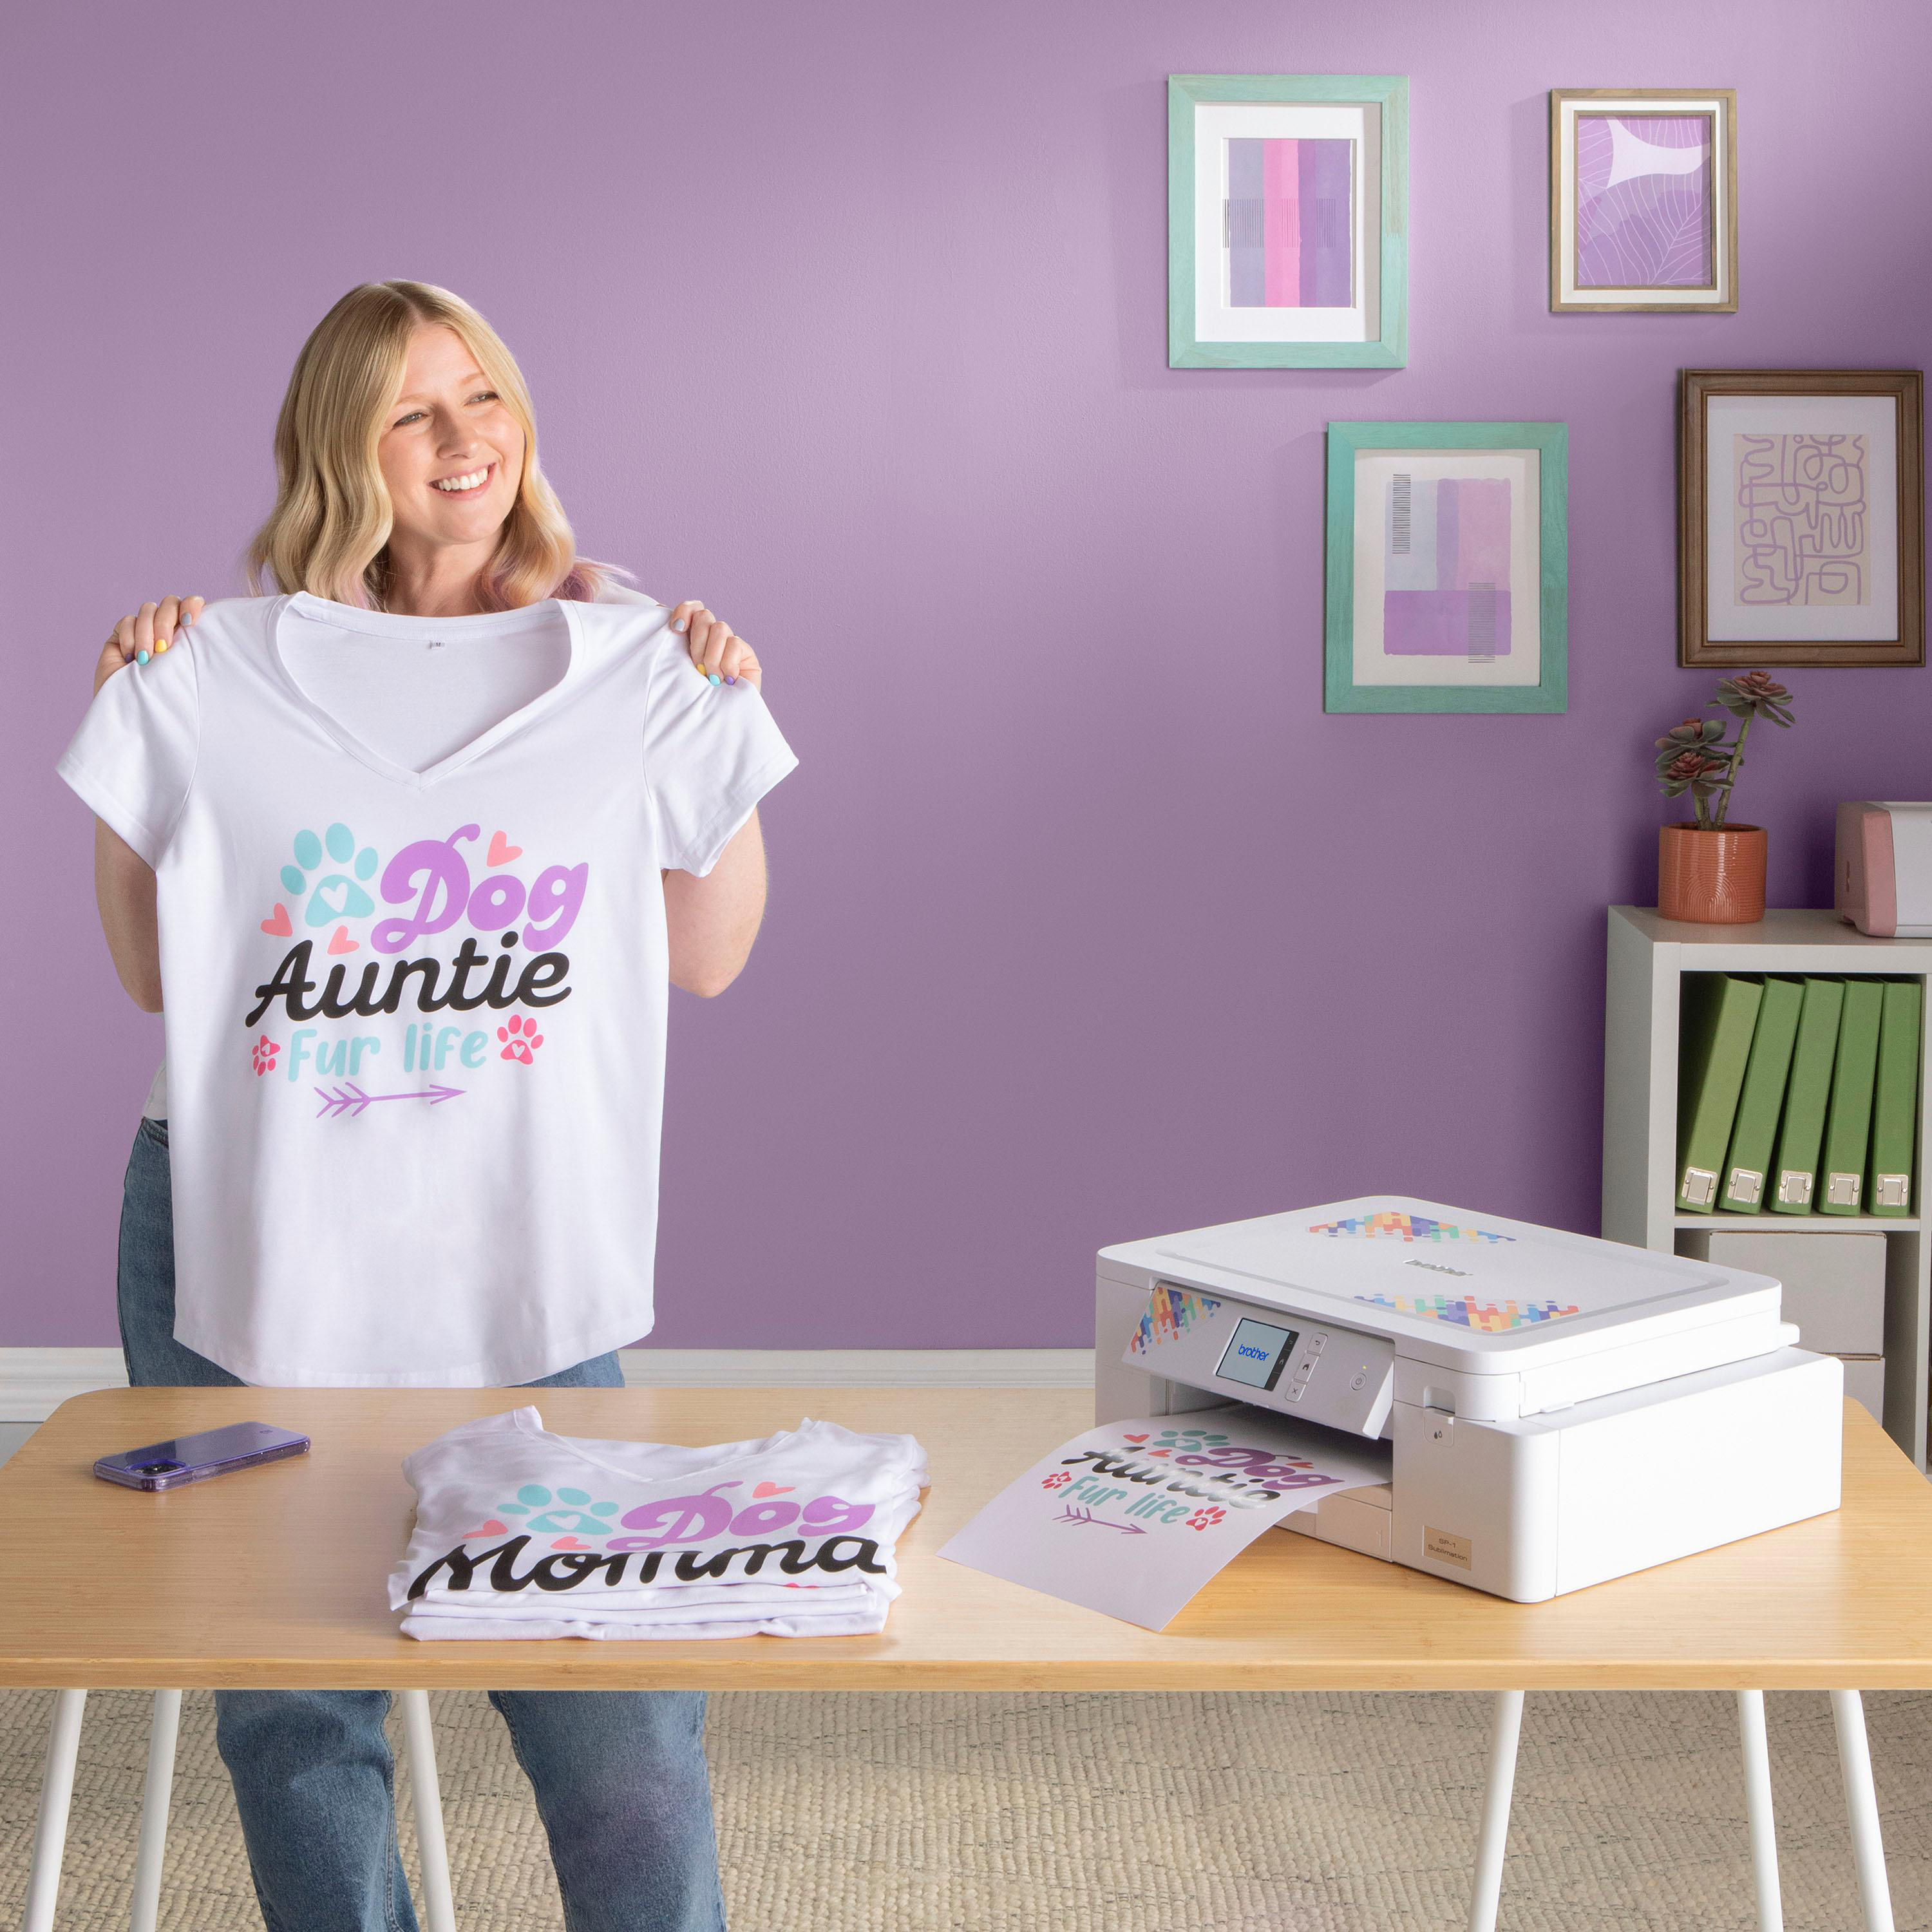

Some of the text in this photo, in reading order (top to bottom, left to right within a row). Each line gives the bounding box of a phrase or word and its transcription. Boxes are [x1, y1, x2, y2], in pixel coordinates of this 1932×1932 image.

[370, 824, 588, 953] Dog
[245, 931, 572, 1027] Auntie
[288, 1022, 488, 1082] Fur life
[1238, 1343, 1269, 1361] brother
[1175, 1447, 1345, 1490] Dog
[605, 1481, 876, 1551] Dog
[1058, 1475, 1191, 1524] Fur life
[407, 1535, 887, 1601] Momma
[1428, 1544, 1468, 1562] Sublimation
[1439, 1538, 1456, 1548] SP-1
